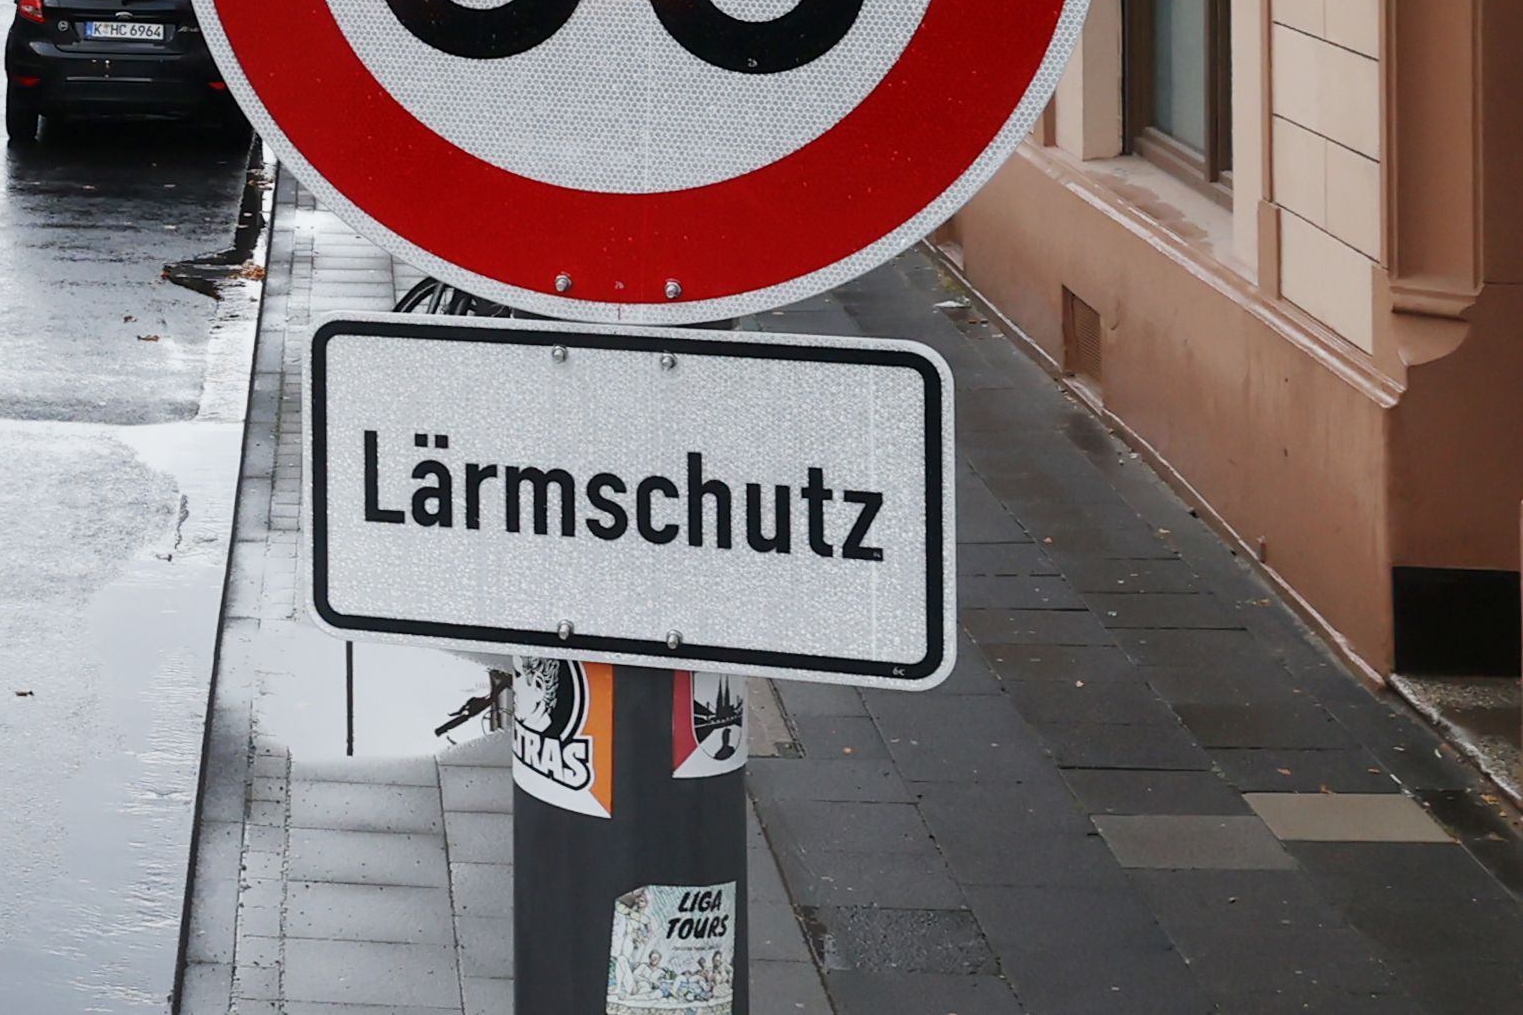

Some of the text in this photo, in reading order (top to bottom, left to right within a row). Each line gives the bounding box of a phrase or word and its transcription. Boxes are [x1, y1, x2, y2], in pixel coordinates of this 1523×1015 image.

[93, 23, 101, 34] K
[110, 24, 127, 35] HC
[129, 25, 162, 37] 6964
[364, 430, 884, 561] Lärmschutz
[677, 889, 723, 913] LIGA
[666, 914, 730, 939] TOURS
